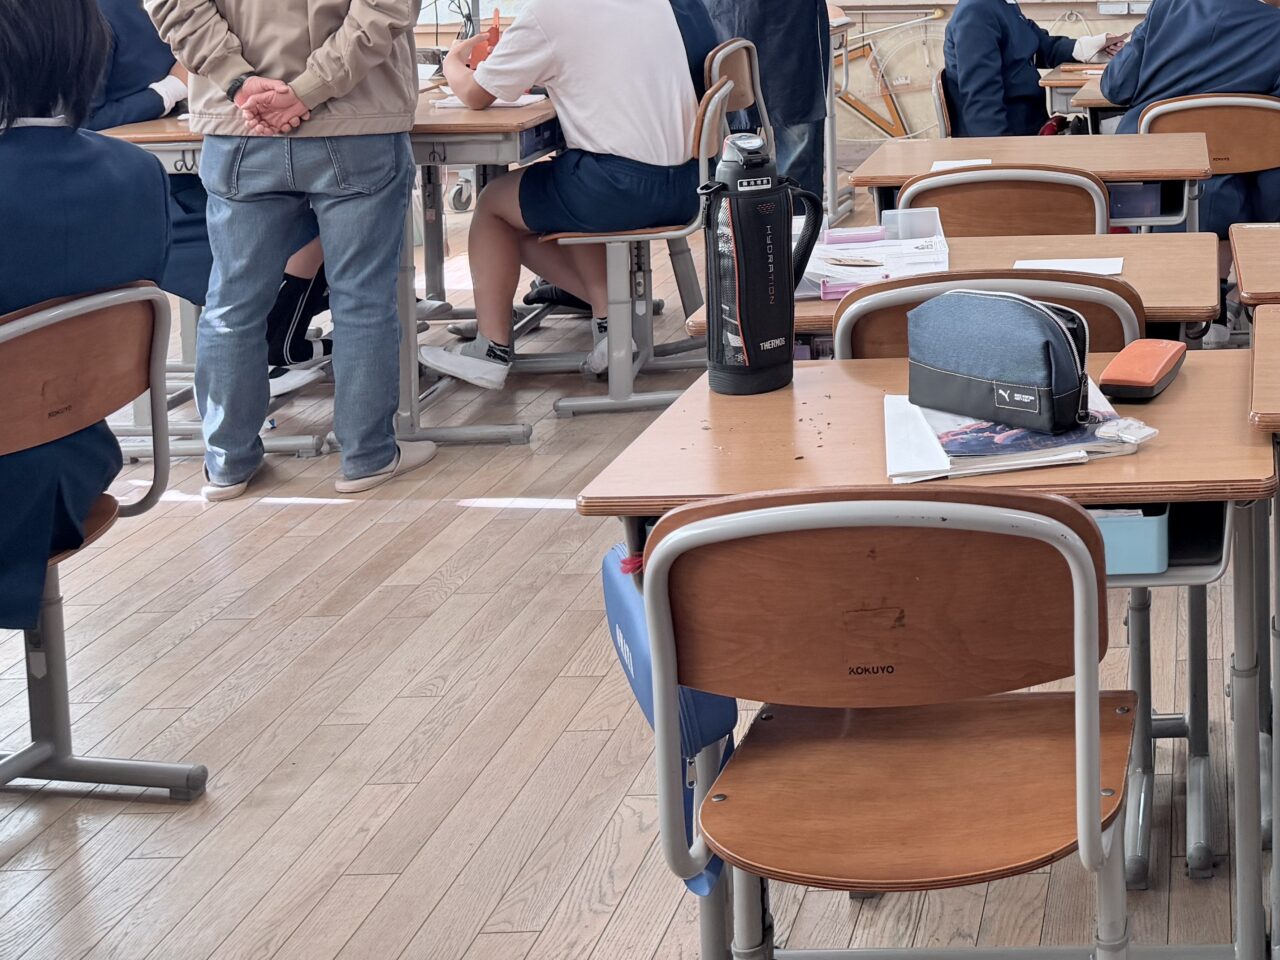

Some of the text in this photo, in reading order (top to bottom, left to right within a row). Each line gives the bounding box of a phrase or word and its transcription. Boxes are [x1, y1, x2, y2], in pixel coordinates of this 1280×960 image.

[766, 225, 775, 305] HYDRATION
[760, 337, 786, 351] THERMOS
[848, 665, 895, 675] KOKUYO
